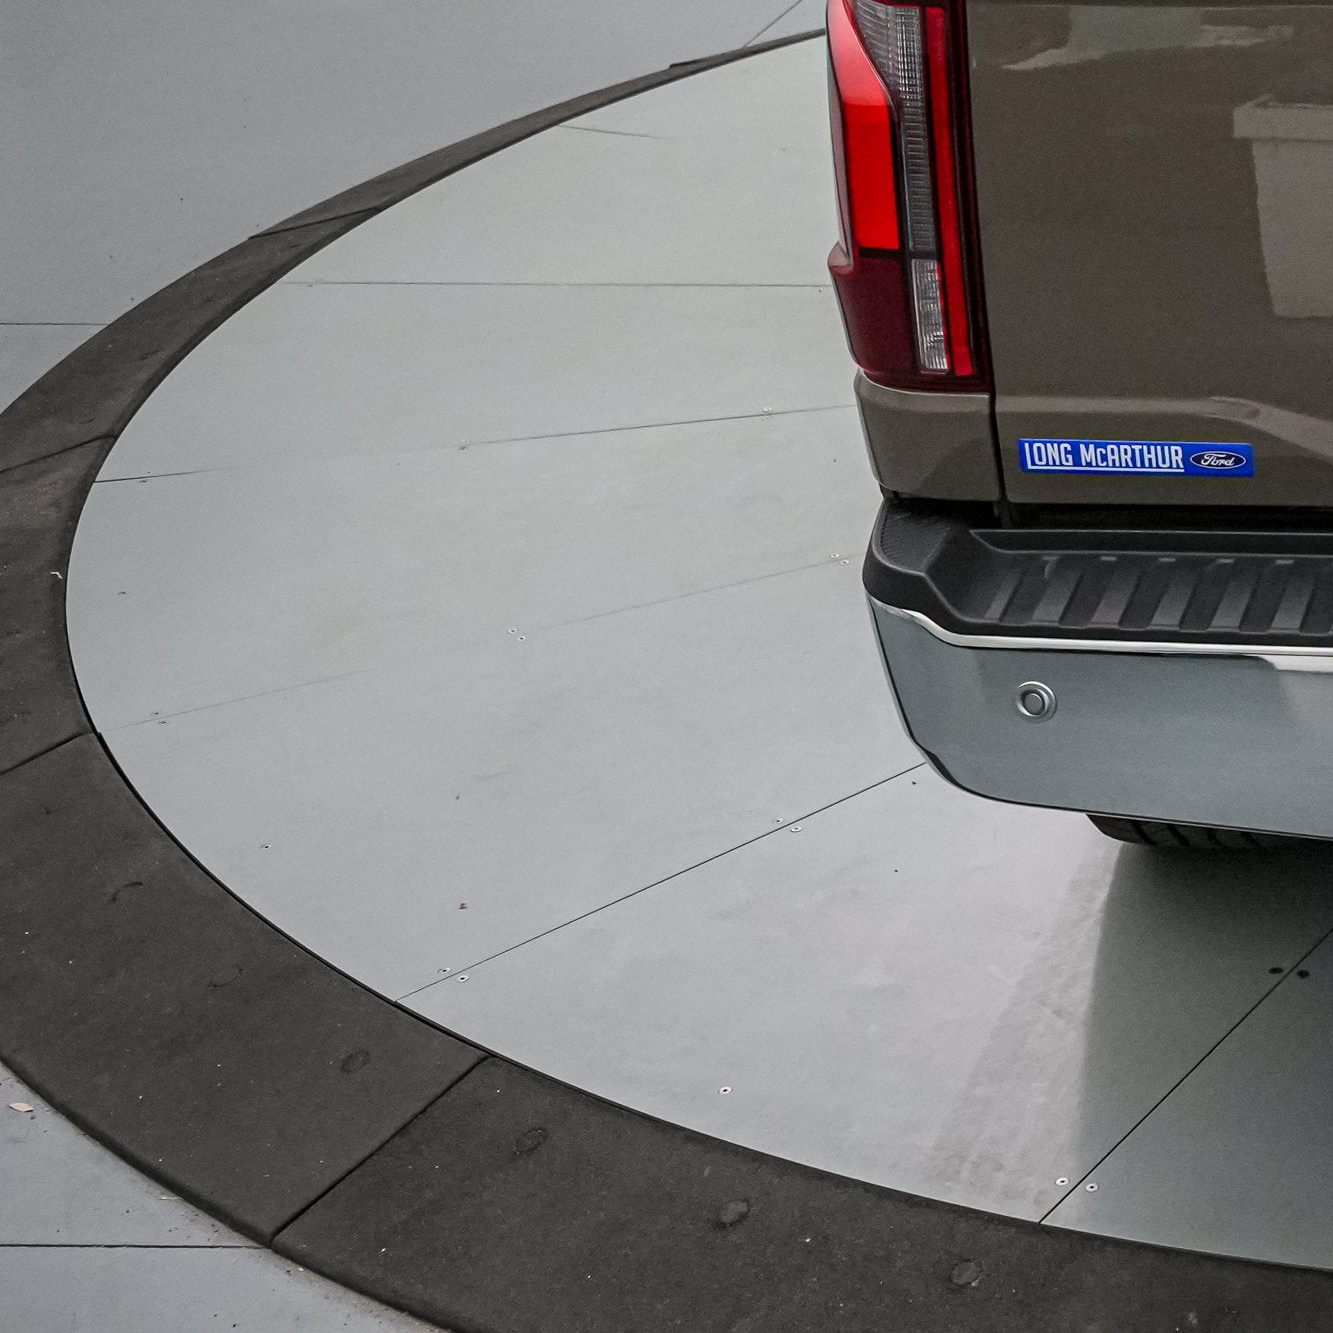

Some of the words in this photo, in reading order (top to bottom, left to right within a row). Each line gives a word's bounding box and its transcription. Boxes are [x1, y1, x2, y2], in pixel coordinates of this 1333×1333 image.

[1025, 442, 1073, 470] LONG
[1080, 444, 1184, 469] McARTHUR
[1200, 453, 1235, 466] Ford
